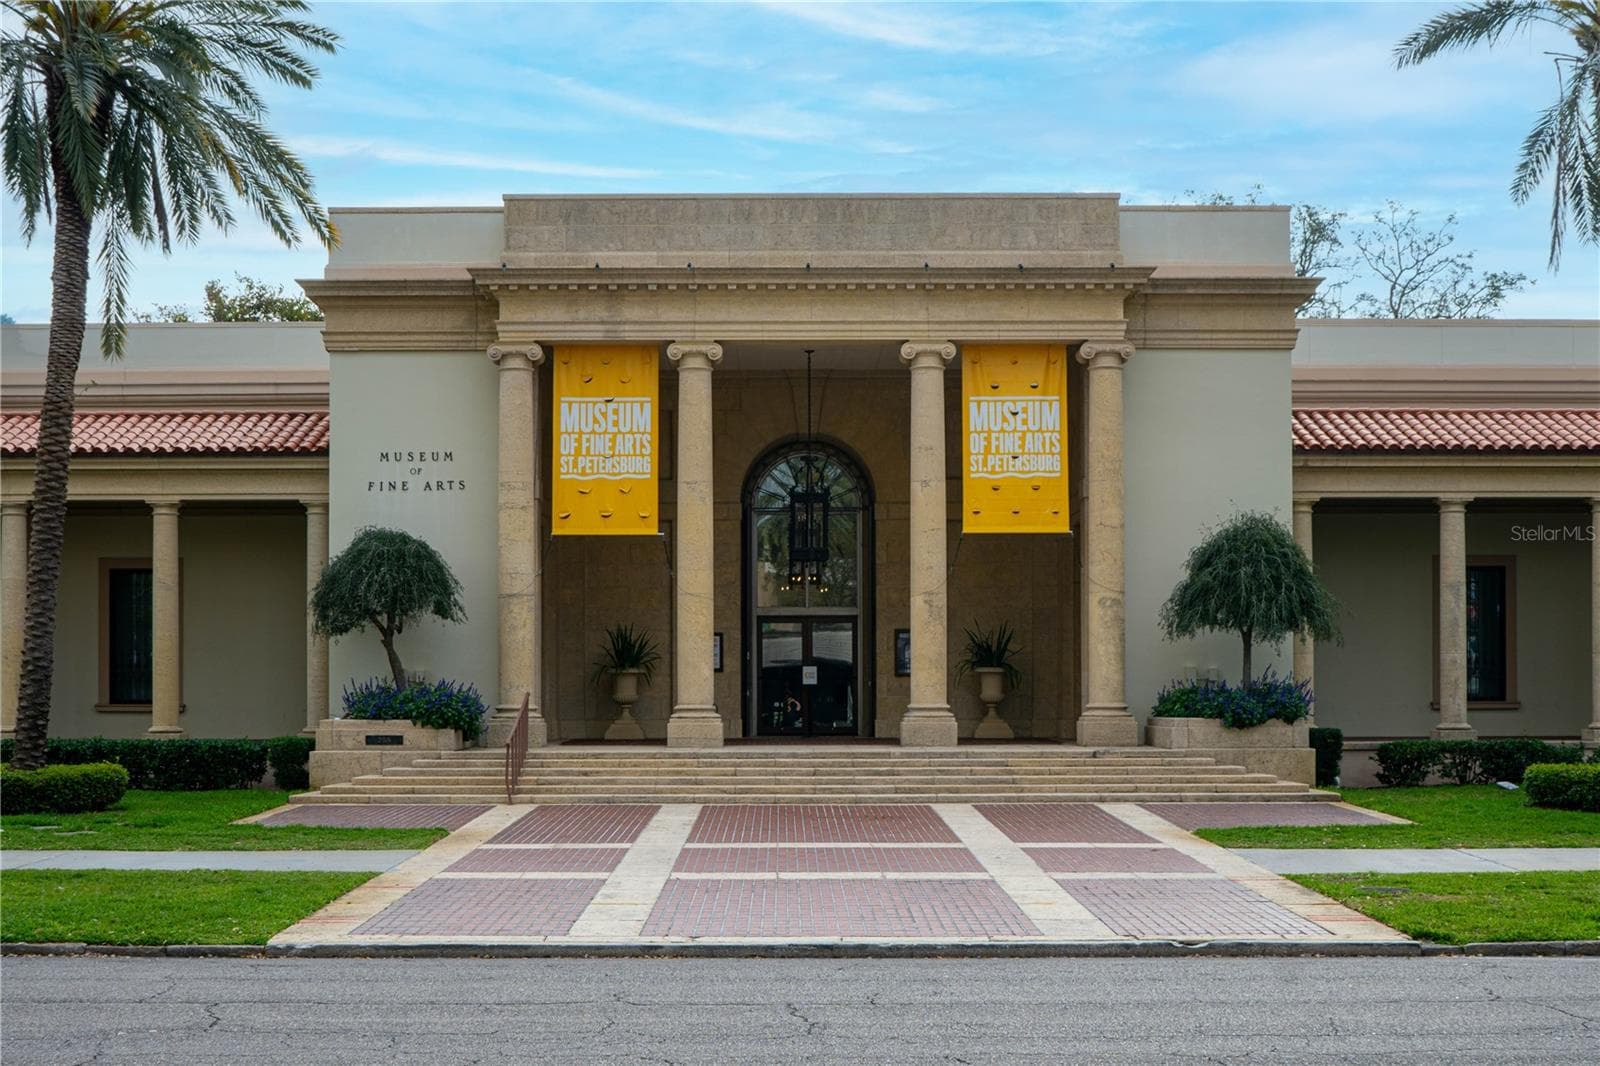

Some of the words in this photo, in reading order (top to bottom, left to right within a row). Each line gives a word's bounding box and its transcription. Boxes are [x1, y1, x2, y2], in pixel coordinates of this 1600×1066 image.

[560, 402, 651, 432] MUSEUM
[969, 401, 1060, 432] MUSEUM
[560, 434, 579, 455] OF
[581, 434, 613, 455] FINE
[615, 434, 652, 455] ARTS
[969, 432, 988, 454] OF
[991, 432, 1023, 454] FINE
[1024, 432, 1061, 454] ARTS
[379, 451, 454, 462] MUSEUM
[409, 467, 423, 476] OF
[367, 481, 409, 491] FINE
[423, 480, 466, 491] ARTS
